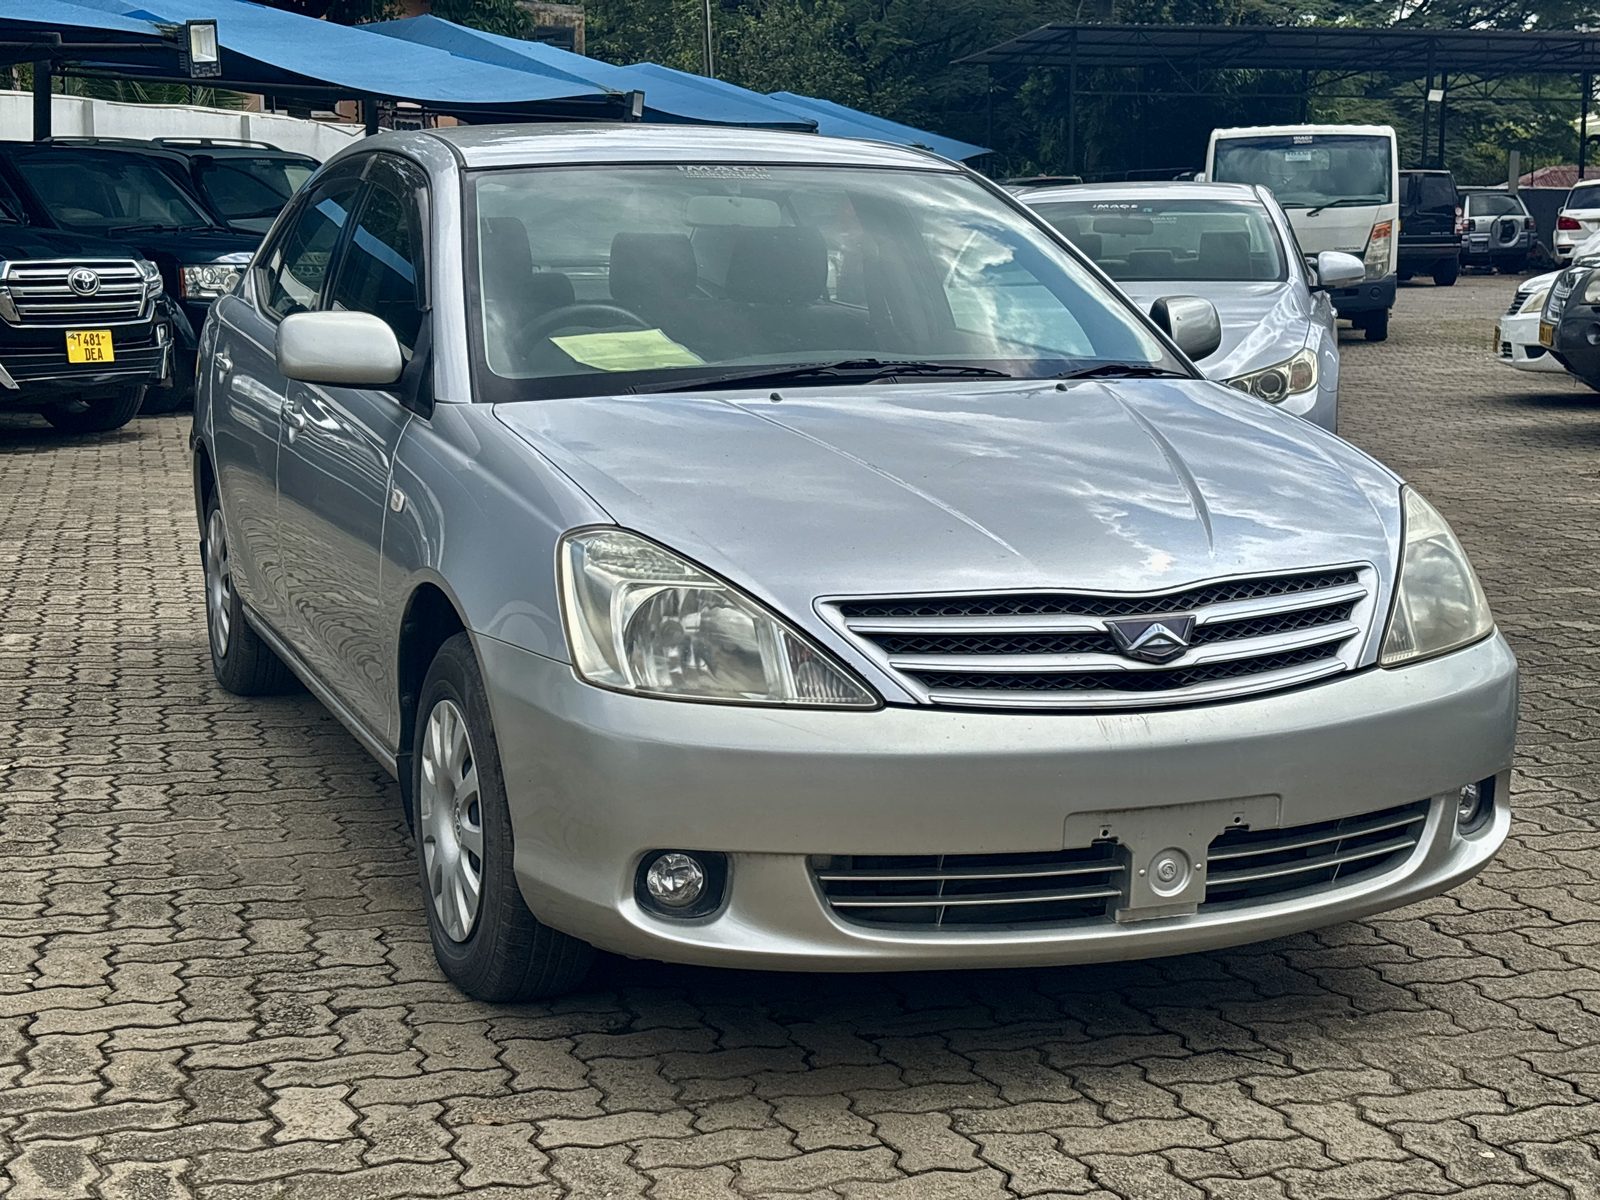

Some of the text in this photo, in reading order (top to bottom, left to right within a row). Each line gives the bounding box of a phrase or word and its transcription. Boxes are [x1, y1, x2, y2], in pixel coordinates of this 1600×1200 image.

[76, 333, 102, 346] T 481
[84, 347, 104, 361] DEA
